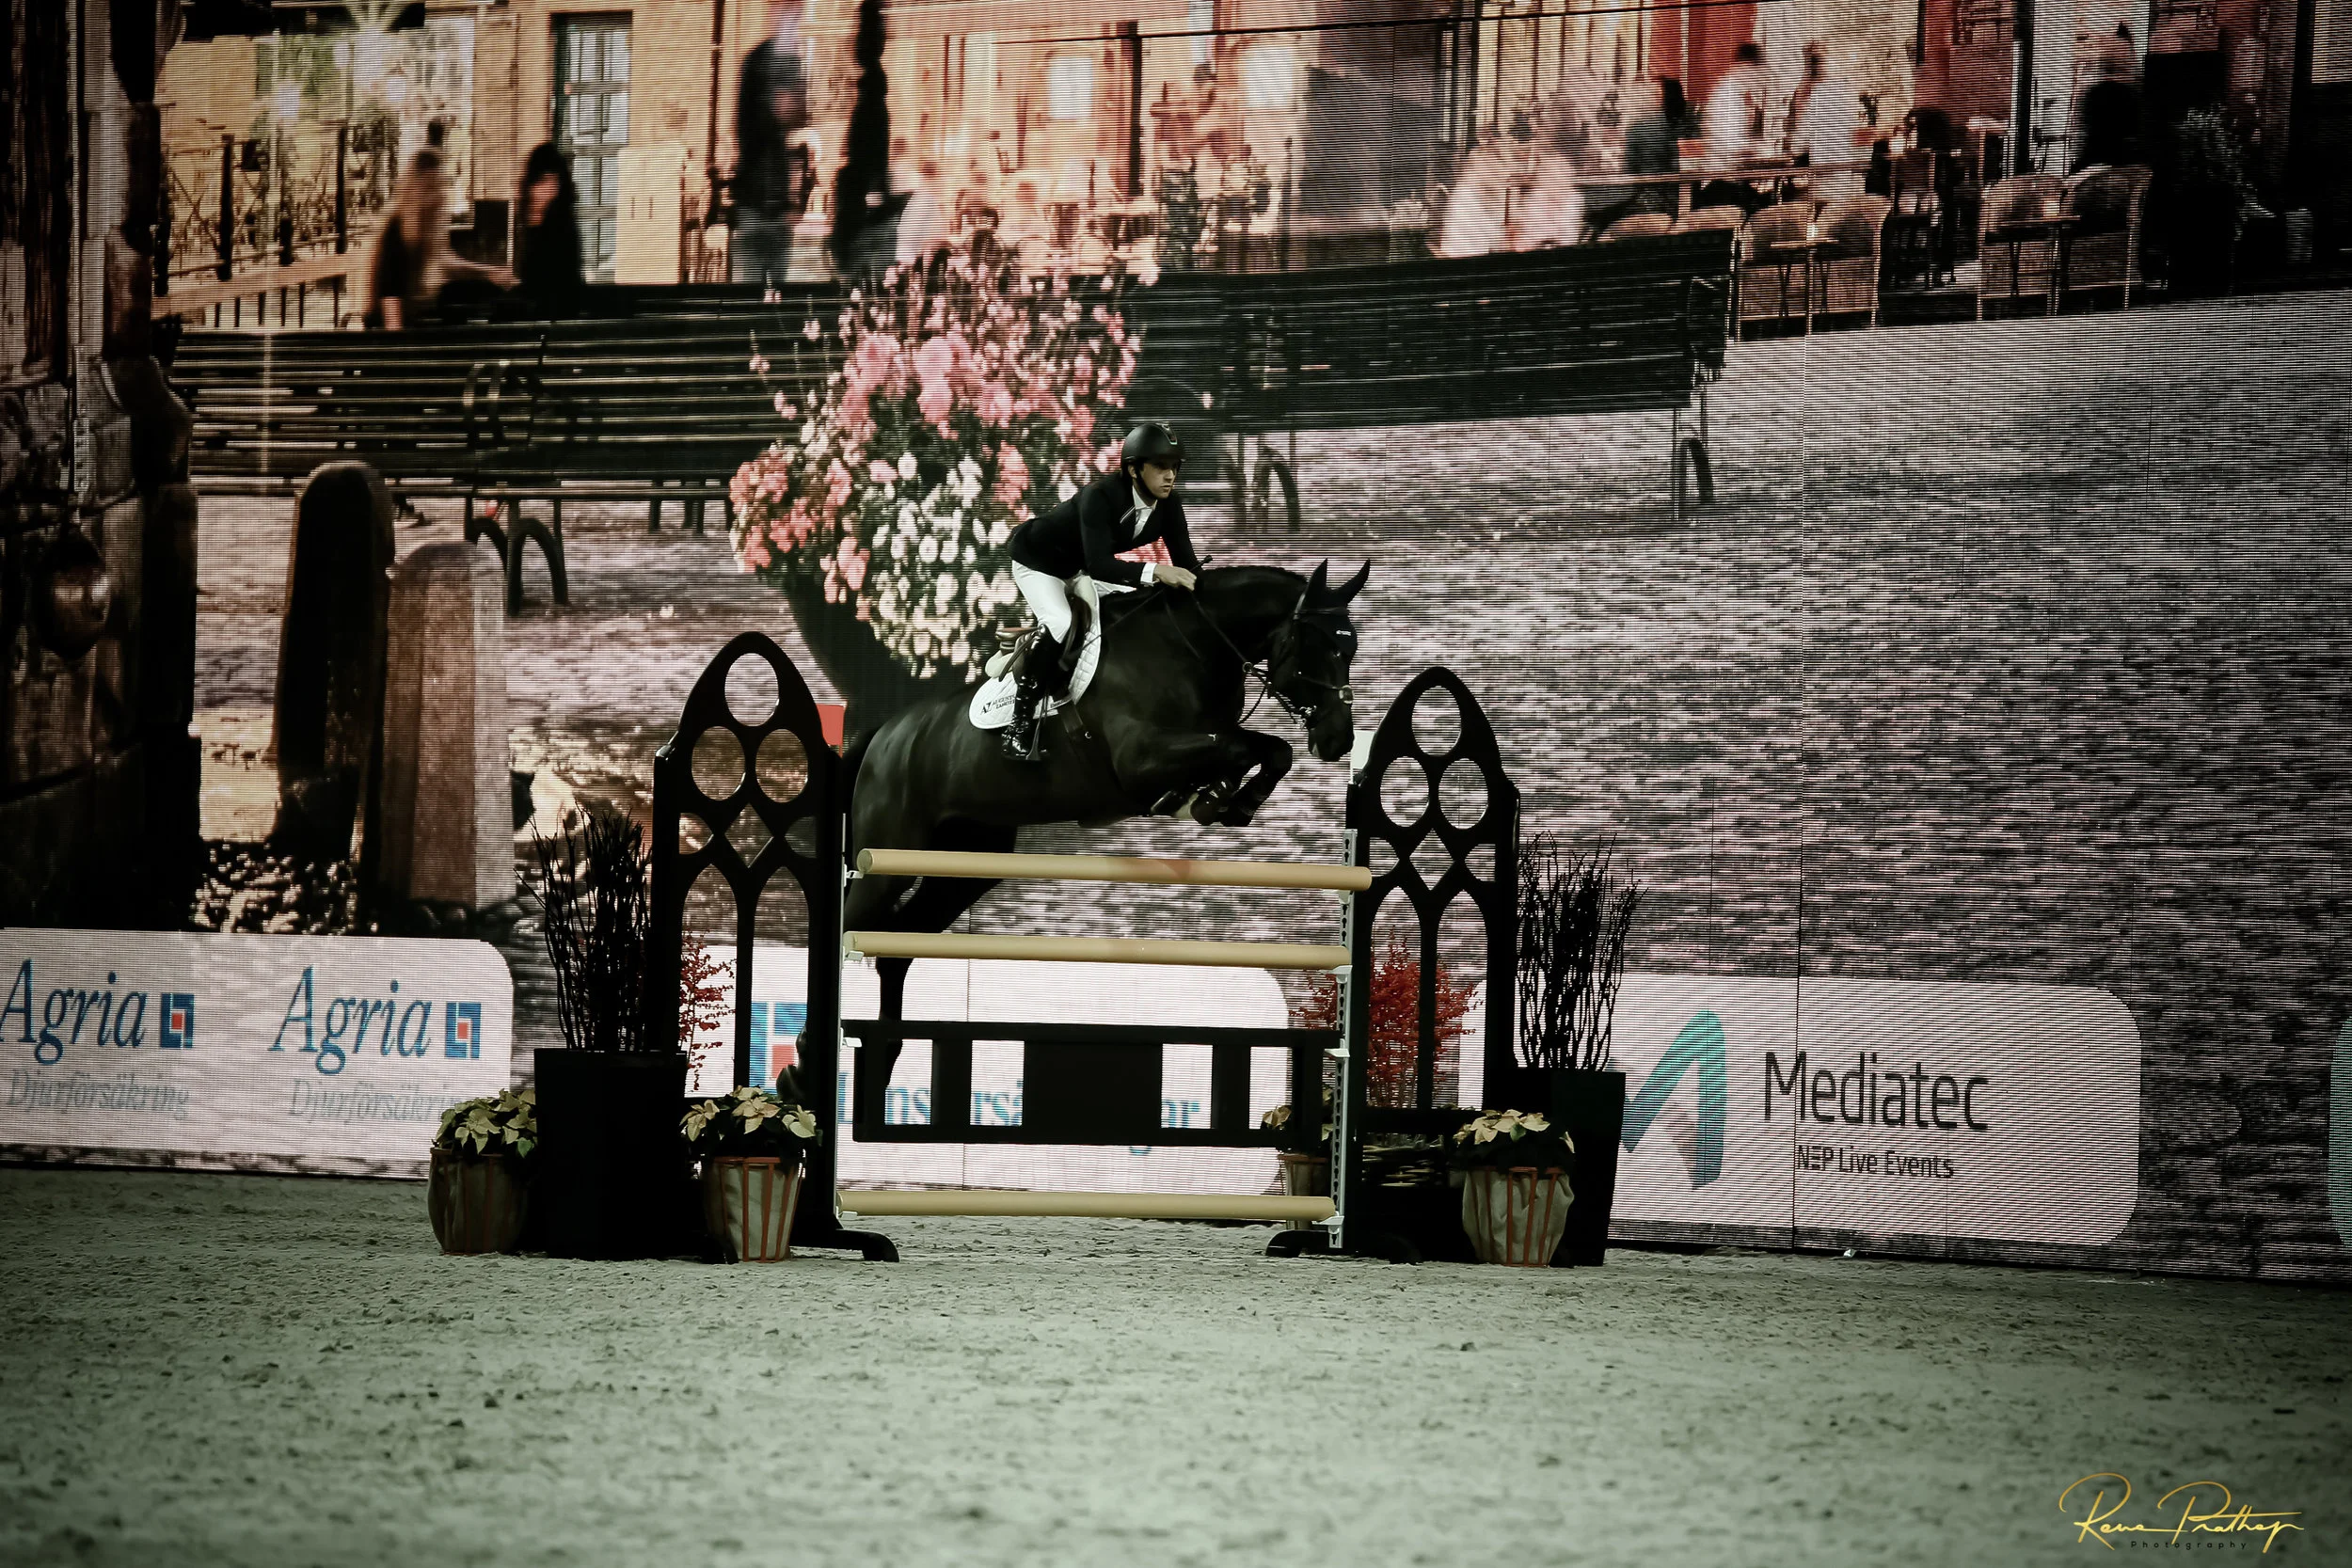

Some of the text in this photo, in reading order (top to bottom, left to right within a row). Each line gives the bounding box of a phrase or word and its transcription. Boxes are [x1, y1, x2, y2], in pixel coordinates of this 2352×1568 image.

[0, 958, 148, 1065] Agria
[267, 964, 433, 1074] Agria
[8, 1069, 188, 1120] Djurförsäkring
[1765, 1051, 1989, 1132] Mediatec
[1796, 1144, 1954, 1179] NEP Live Events
